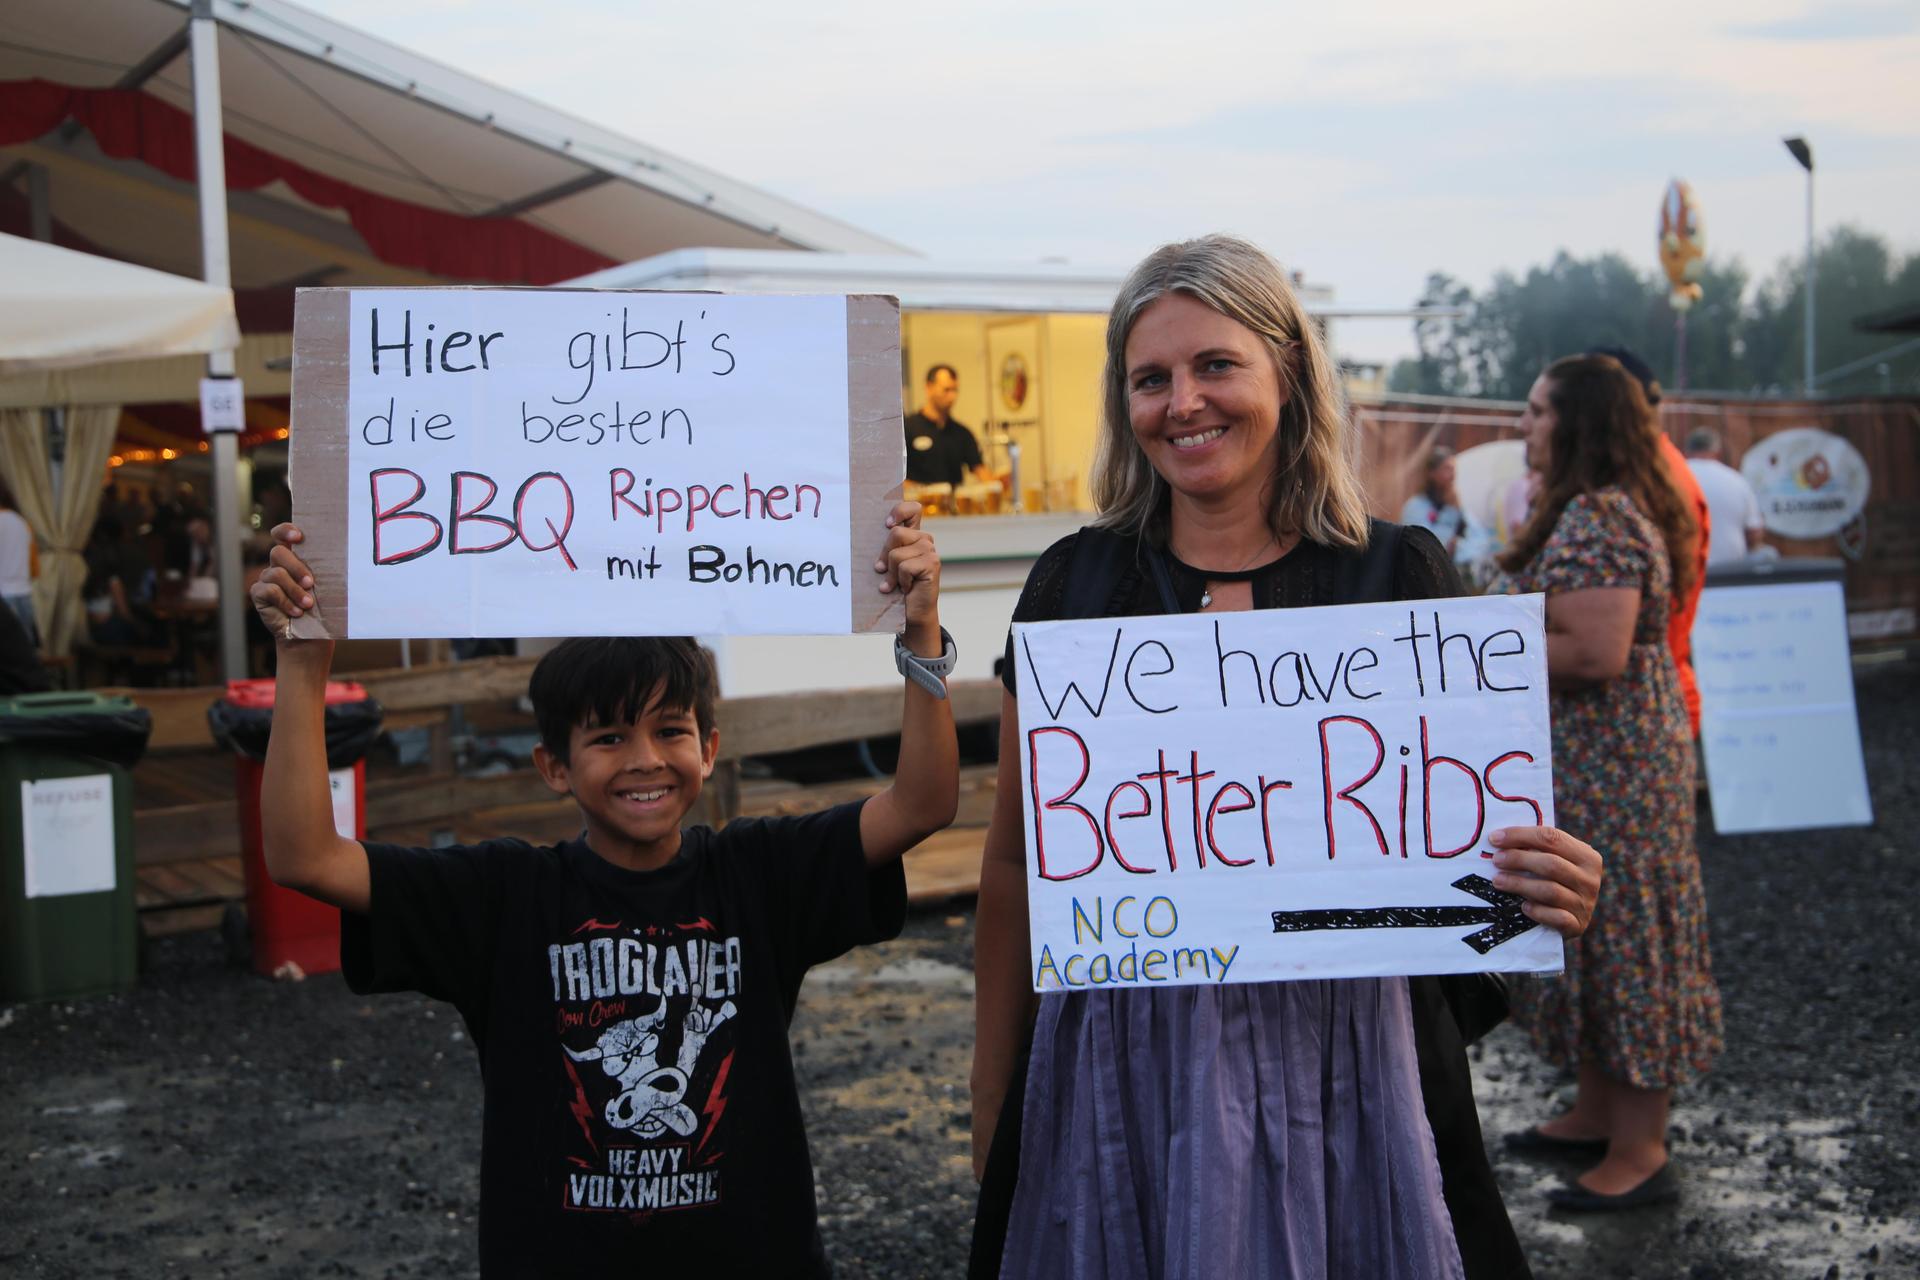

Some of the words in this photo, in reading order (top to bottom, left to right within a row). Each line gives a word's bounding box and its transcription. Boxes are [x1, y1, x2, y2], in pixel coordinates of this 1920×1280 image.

[371, 307, 505, 378] Hier
[552, 307, 735, 405] gibt's
[363, 397, 456, 446] die
[522, 401, 693, 446] besten
[369, 467, 578, 571] BBQ
[609, 468, 822, 534] Rippchen
[606, 545, 663, 581] mit
[687, 545, 840, 588] Bohnen
[1021, 626, 1179, 721] We
[1214, 620, 1383, 708] have
[1393, 610, 1530, 698] the
[1027, 725, 1293, 882] Better
[1317, 714, 1544, 861] Ribs
[1072, 895, 1179, 945] NCO
[1035, 942, 1240, 988] Academy
[558, 1007, 584, 1034] Cow
[588, 999, 626, 1028] Crew
[608, 1147, 684, 1176] HEAVY
[569, 1170, 719, 1210] VOLXMUSIC
